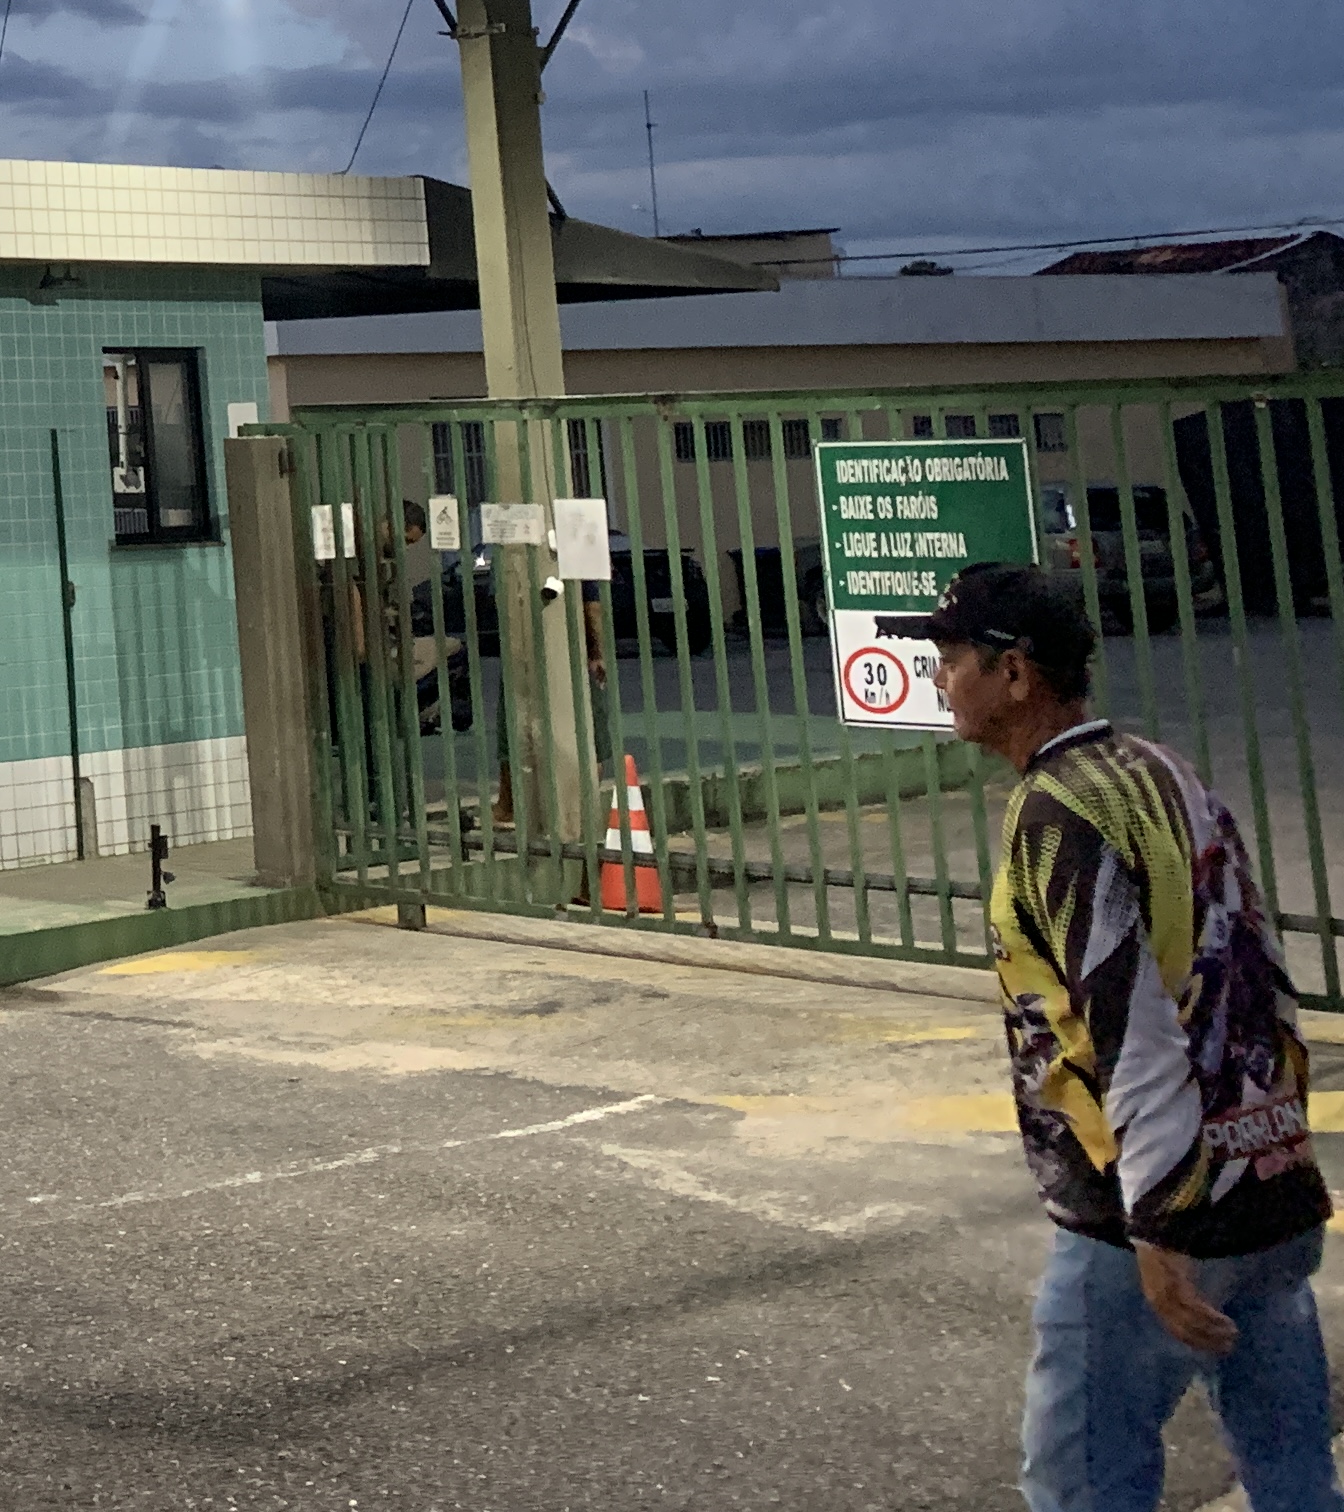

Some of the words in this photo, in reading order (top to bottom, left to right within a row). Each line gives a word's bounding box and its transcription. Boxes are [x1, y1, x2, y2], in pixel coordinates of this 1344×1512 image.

[835, 456, 923, 486] IDENTIFICAÇÃO
[925, 451, 1010, 482] OBRIGATÓRIA
[839, 494, 875, 520] BAIXE
[876, 495, 894, 520] OS
[895, 490, 939, 520] FARÓIS
[842, 531, 879, 558] LIGUE
[880, 531, 890, 558] A
[889, 531, 914, 558] LUZ
[914, 531, 968, 558] INTERNA
[846, 570, 938, 597] IDENTIFIQUE-SE
[863, 661, 887, 686] 30
